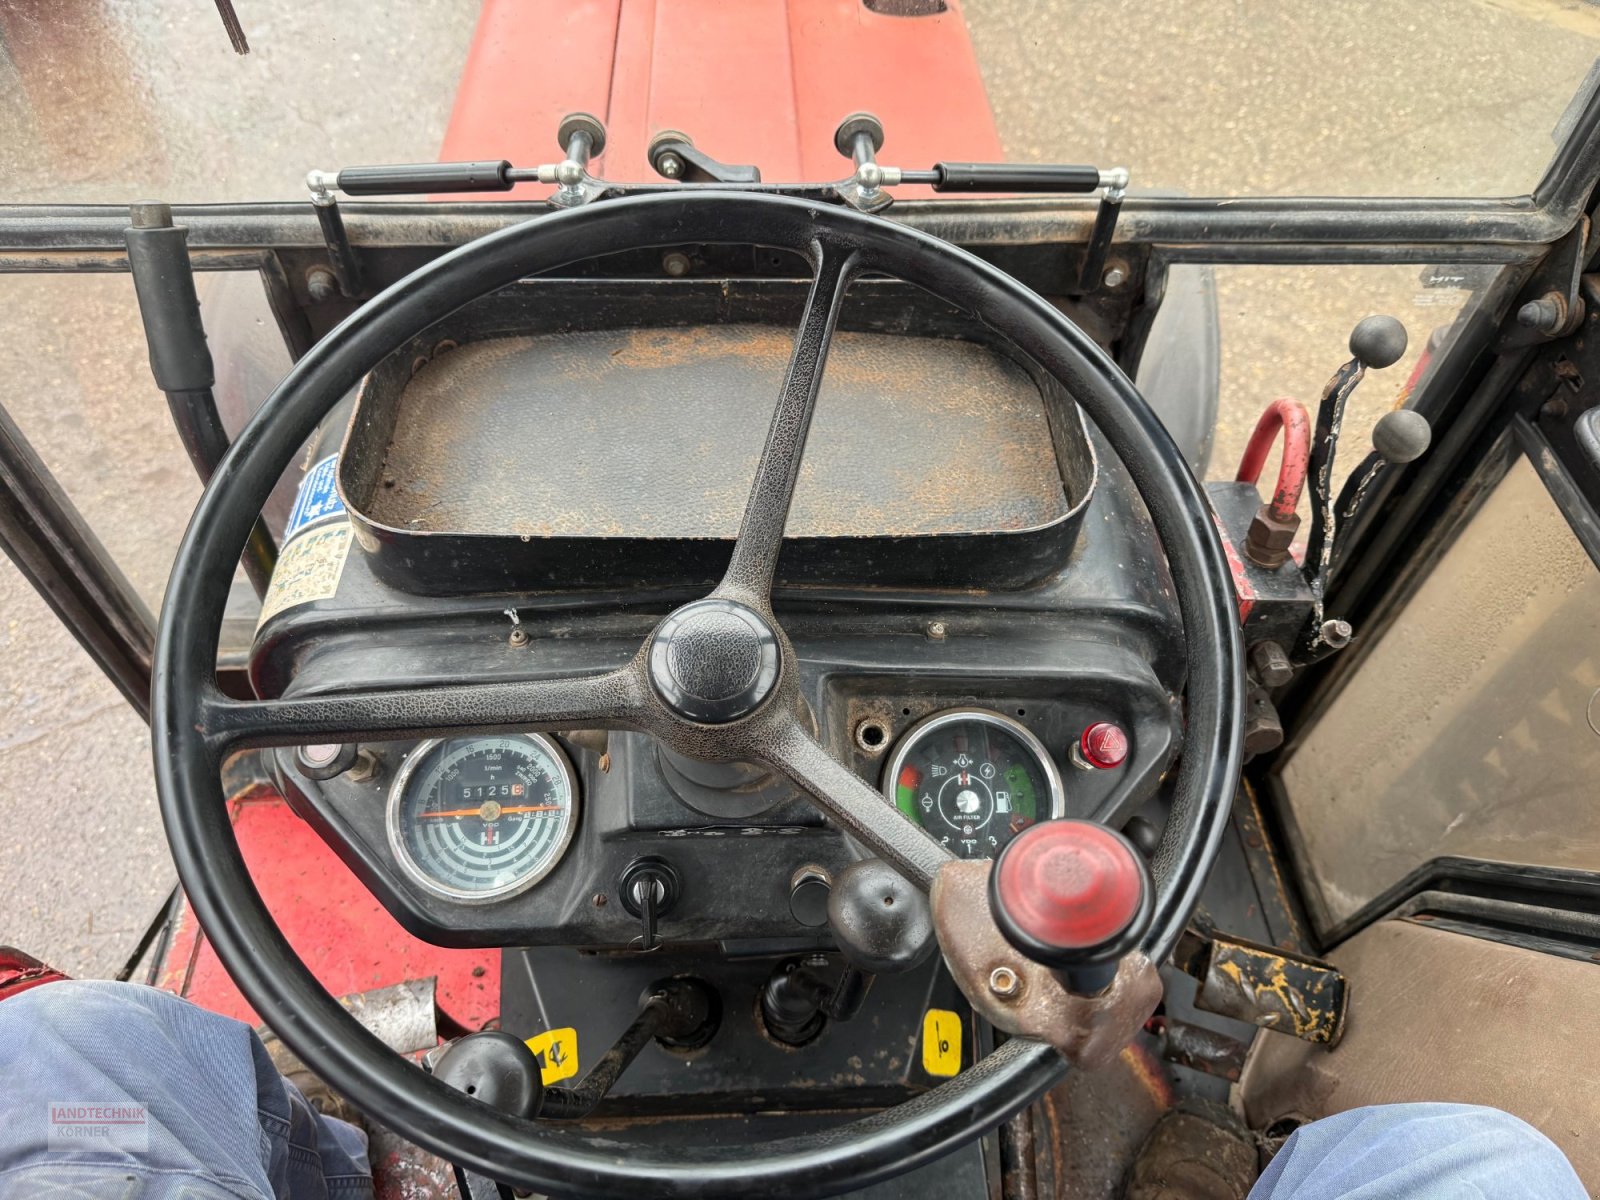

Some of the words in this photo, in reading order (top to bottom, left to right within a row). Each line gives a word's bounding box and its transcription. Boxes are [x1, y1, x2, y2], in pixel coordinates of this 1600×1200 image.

[465, 745, 475, 754] 16
[499, 740, 510, 748] 20
[530, 750, 541, 761] 24
[445, 768, 460, 782] 1000
[486, 753, 502, 761] 1500
[526, 763, 541, 778] 2000
